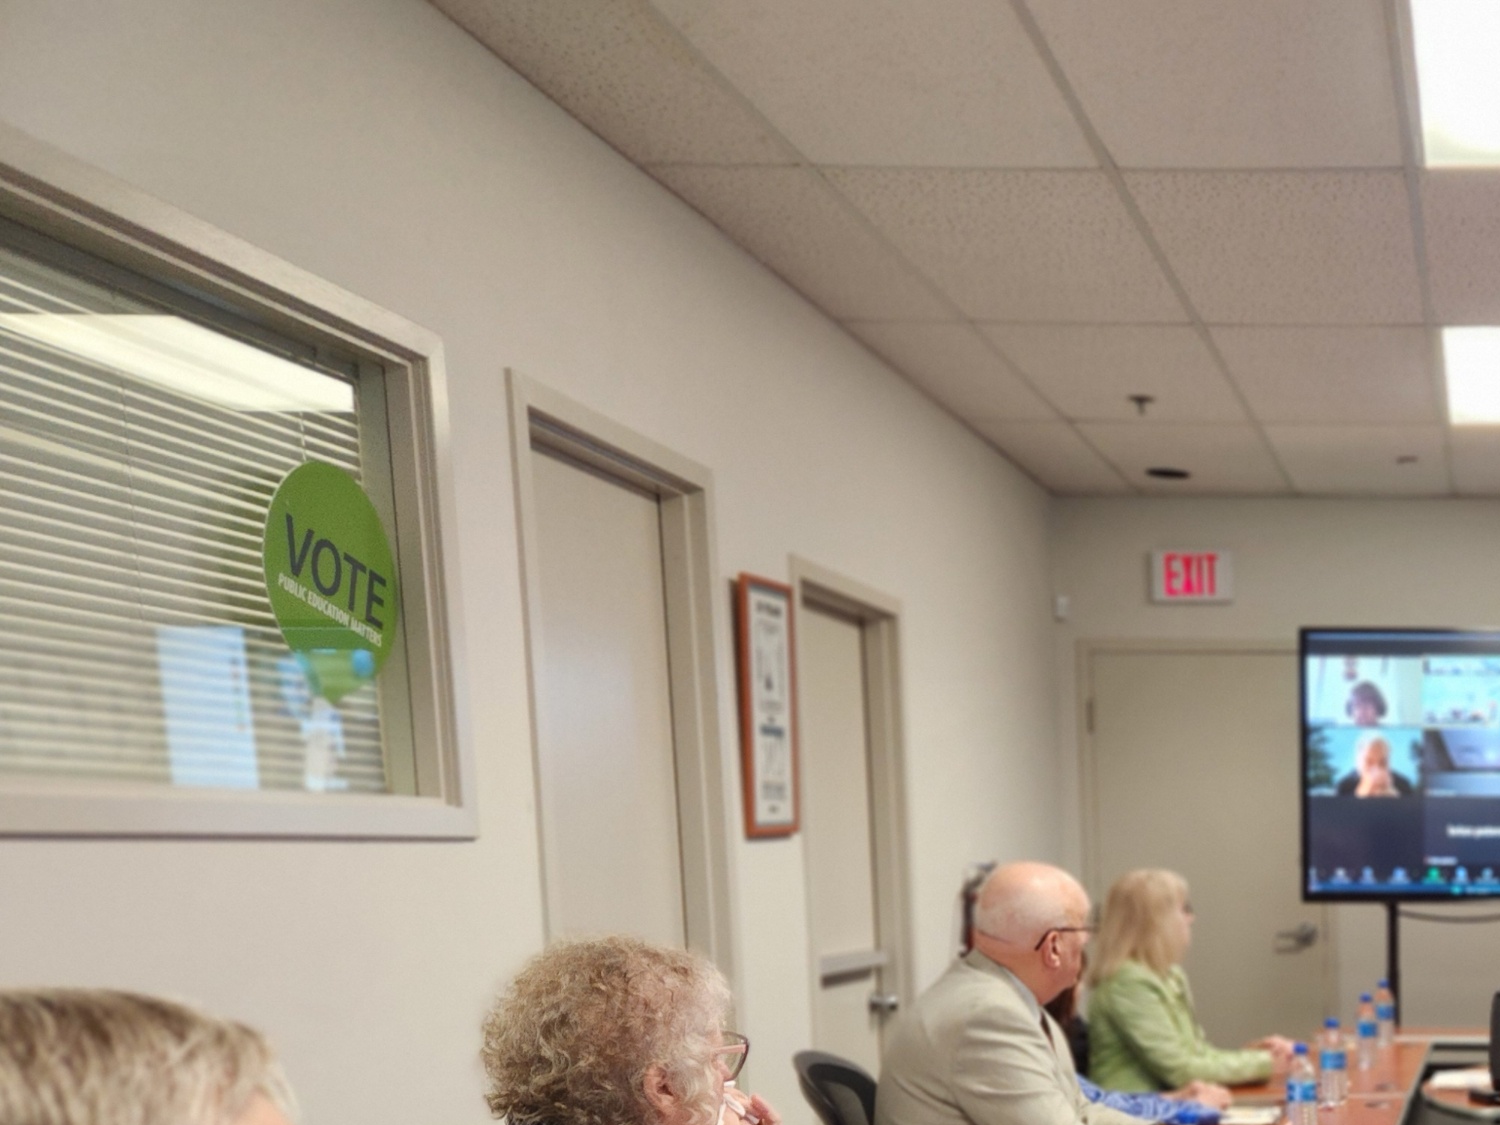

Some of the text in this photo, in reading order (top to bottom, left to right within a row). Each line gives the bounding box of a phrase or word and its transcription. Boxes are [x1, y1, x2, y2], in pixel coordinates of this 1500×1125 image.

[286, 513, 387, 629] VOTE
[1163, 552, 1217, 597] EXIT
[278, 573, 382, 647] PUBLIC EDUCATION MATTERS
